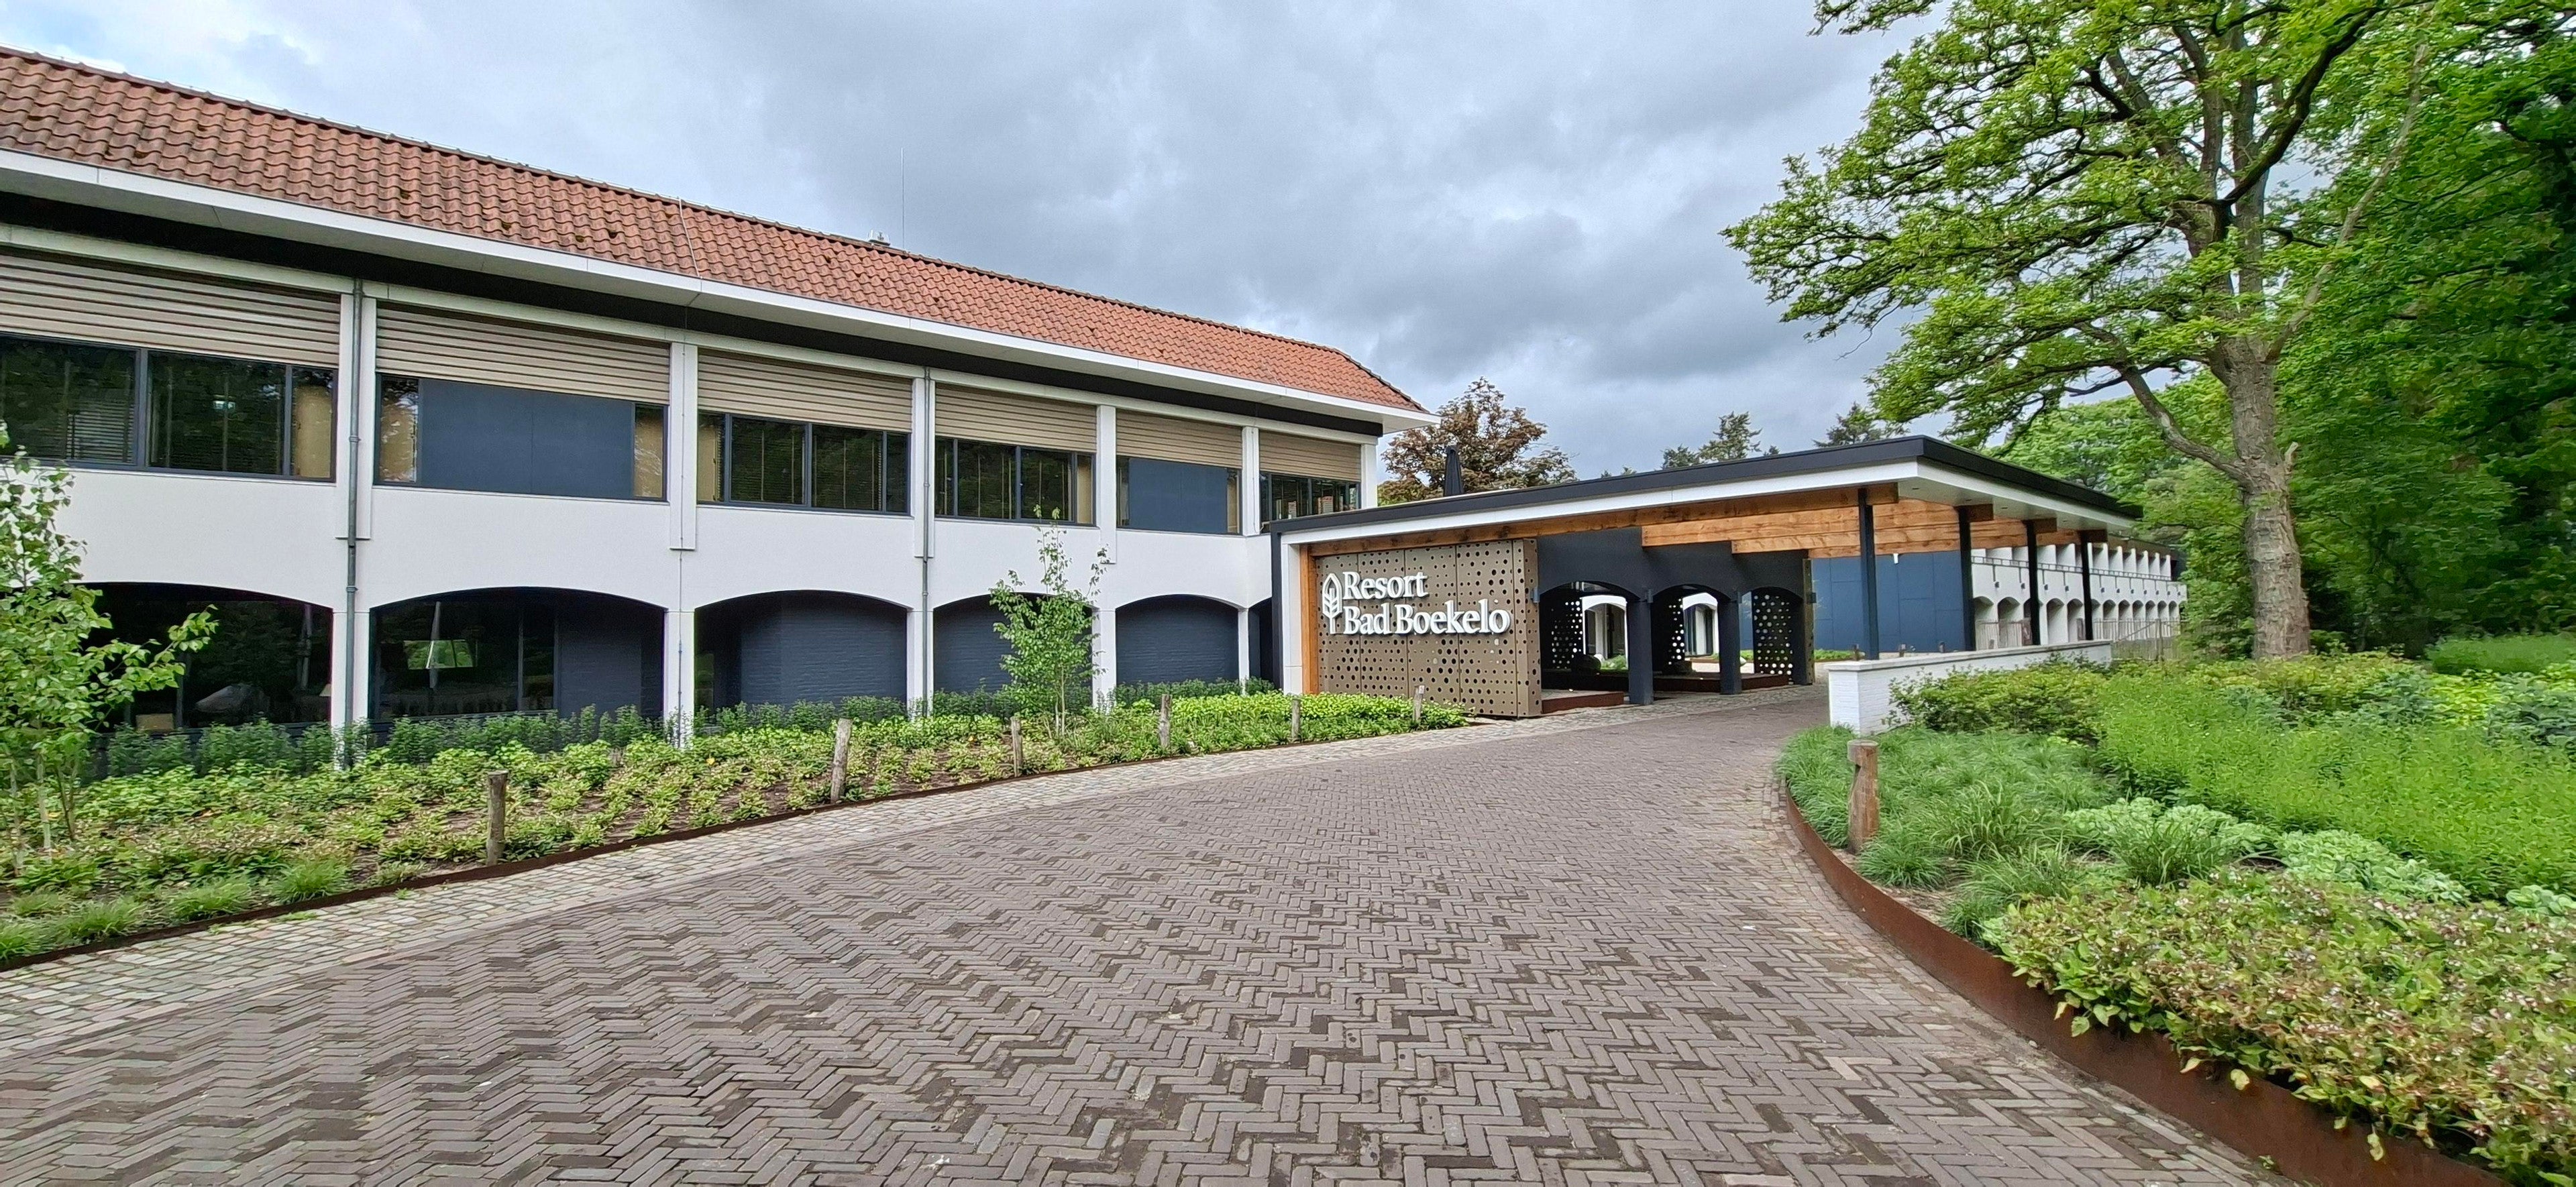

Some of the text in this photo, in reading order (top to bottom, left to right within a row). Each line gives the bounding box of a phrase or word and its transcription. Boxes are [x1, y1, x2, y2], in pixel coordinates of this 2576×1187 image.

[1342, 571, 1428, 600] Resort
[1342, 599, 1510, 634] Bad Boekelo
